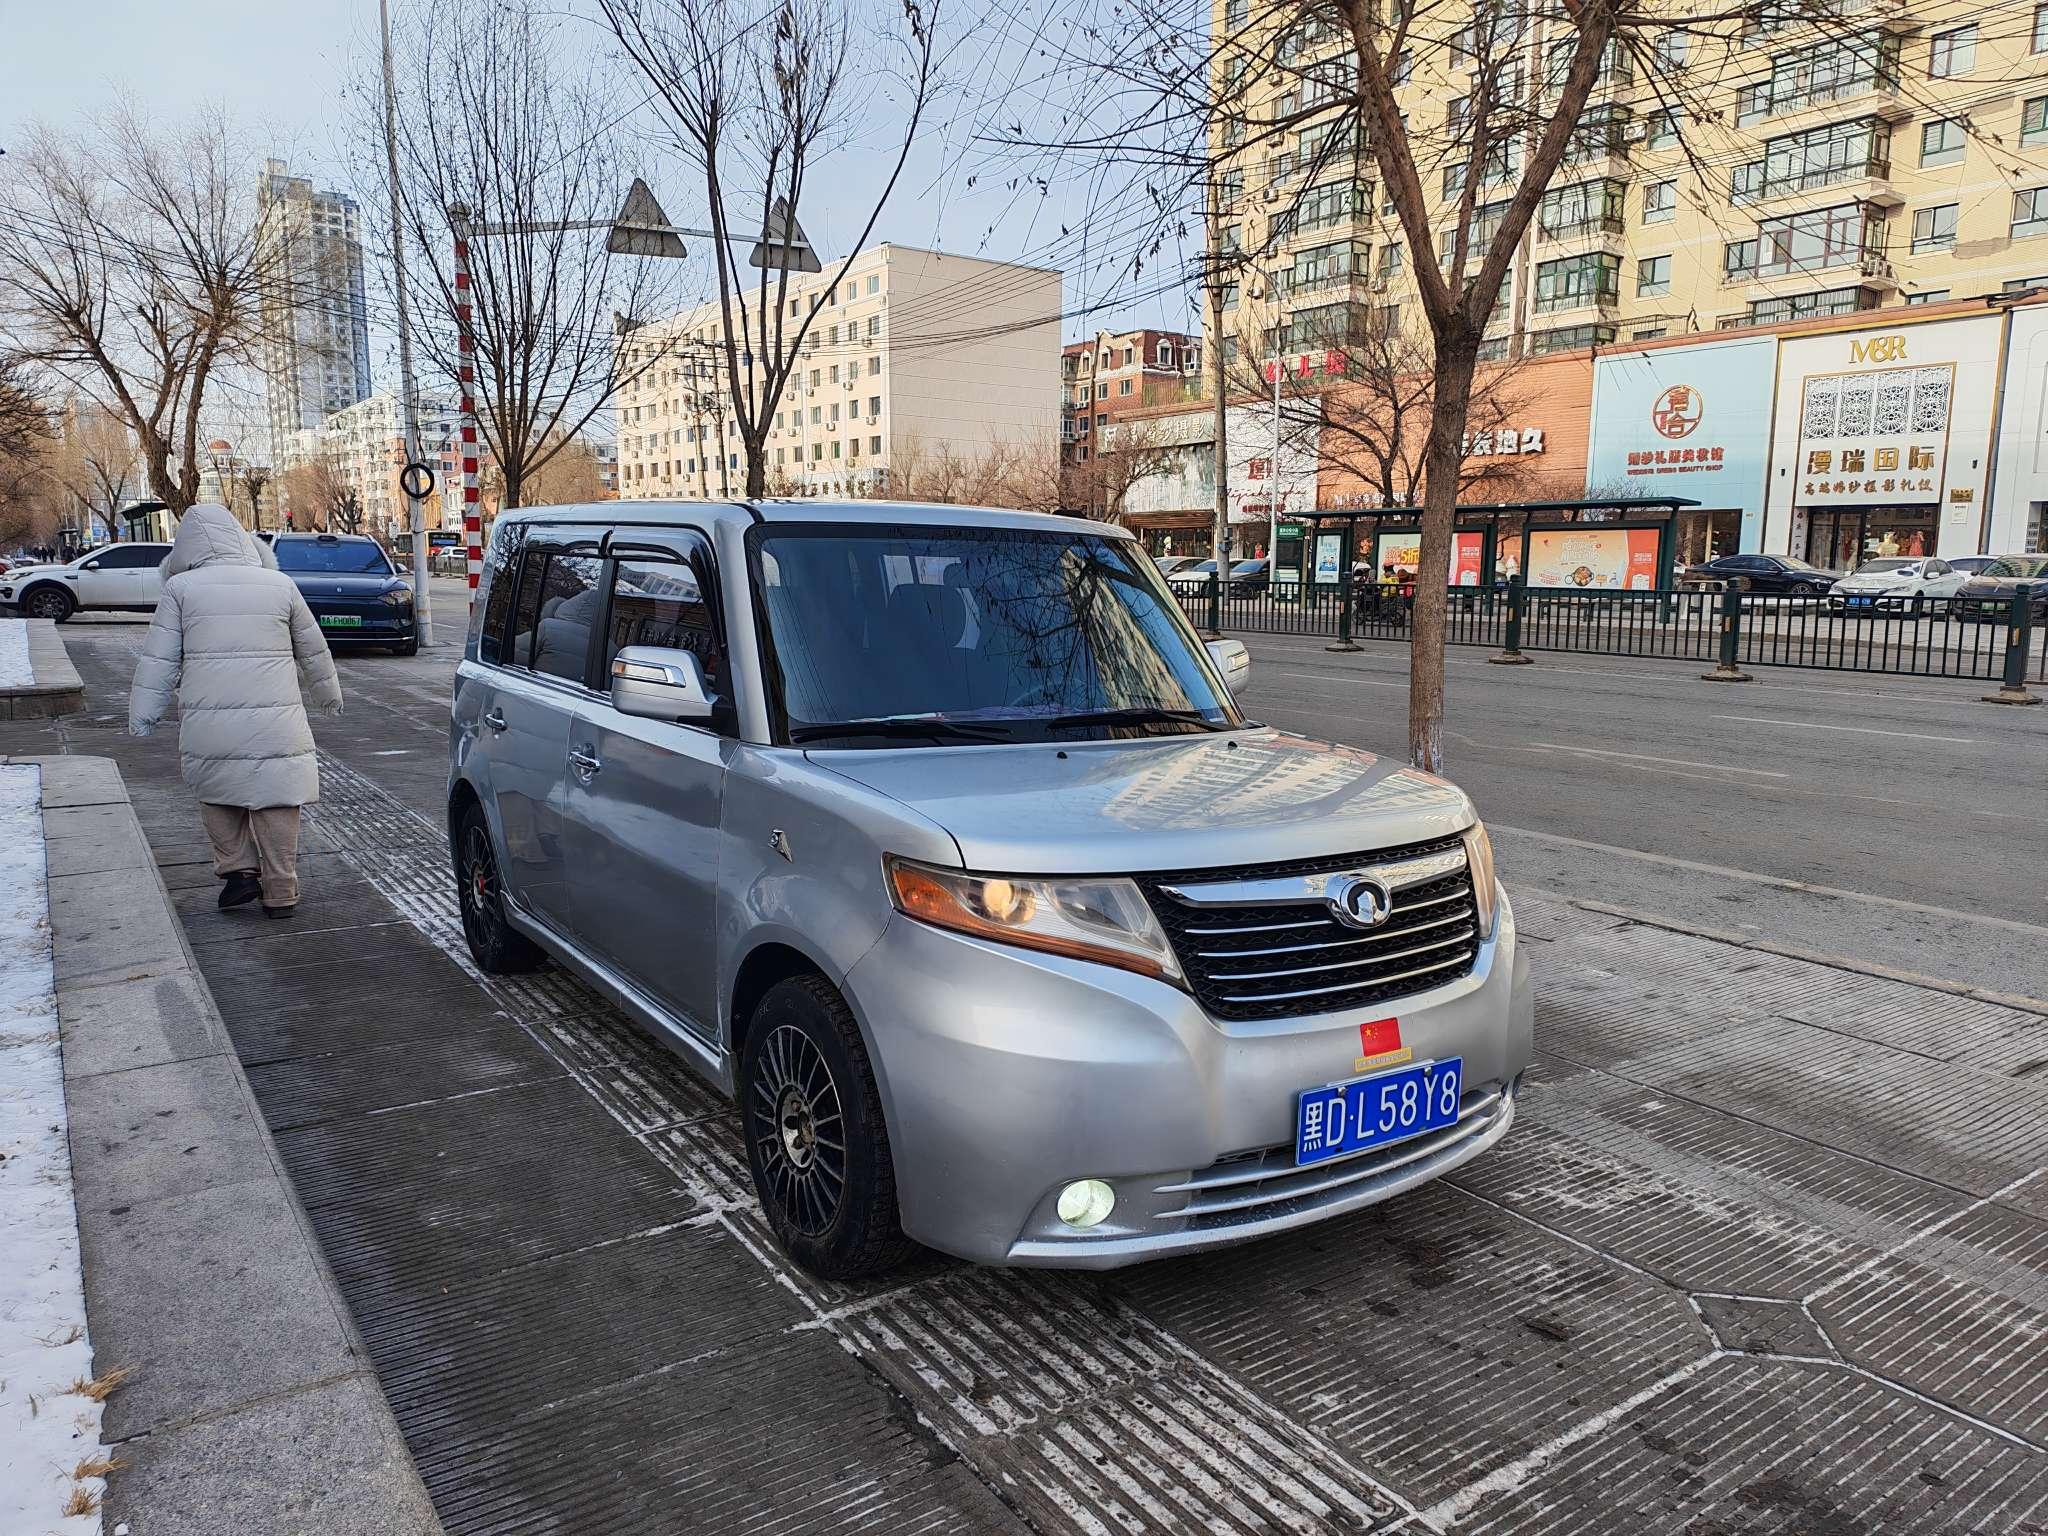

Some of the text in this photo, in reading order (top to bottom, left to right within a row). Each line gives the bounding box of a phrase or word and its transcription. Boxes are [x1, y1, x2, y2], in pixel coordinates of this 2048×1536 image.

[1848, 335, 1908, 363] M&R
[1807, 446, 1936, 474] 漫瑞国际
